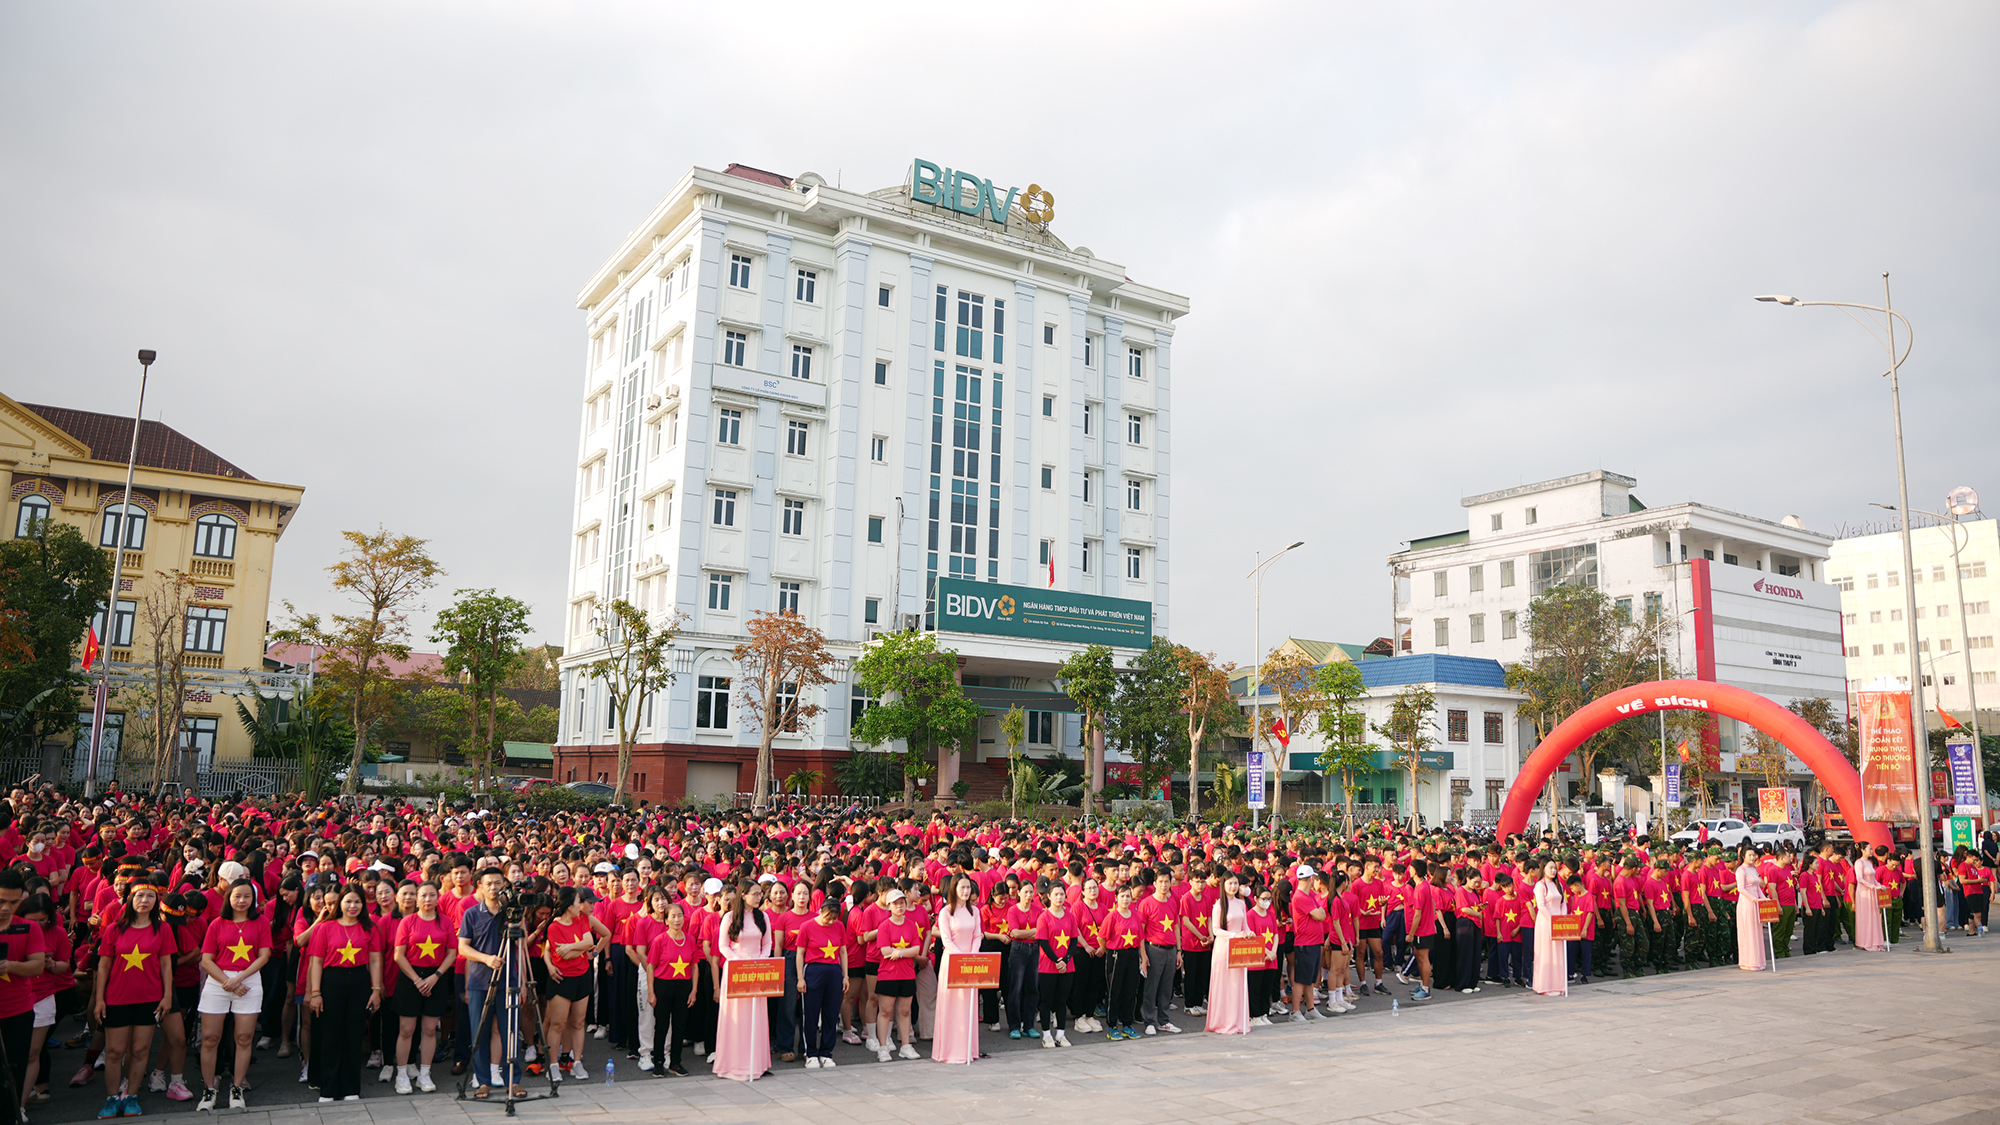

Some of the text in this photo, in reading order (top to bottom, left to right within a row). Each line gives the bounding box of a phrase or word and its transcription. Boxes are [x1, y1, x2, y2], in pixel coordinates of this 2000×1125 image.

[910, 157, 1020, 224] BIDV
[763, 380, 777, 389] BSC
[1765, 584, 1804, 600] HONDA
[946, 593, 999, 620] BIDV
[1023, 601, 1038, 610] NGÂN
[1038, 603, 1053, 611] HÀNG
[1068, 606, 1080, 614] ĐẦU
[1095, 609, 1107, 617] PHÁT
[1108, 610, 1122, 619] TRIỂN
[1123, 612, 1133, 620] VIỆT
[1654, 695, 1708, 708] ĐÍCH
[960, 963, 988, 974] TỈNH ĐOÀN
